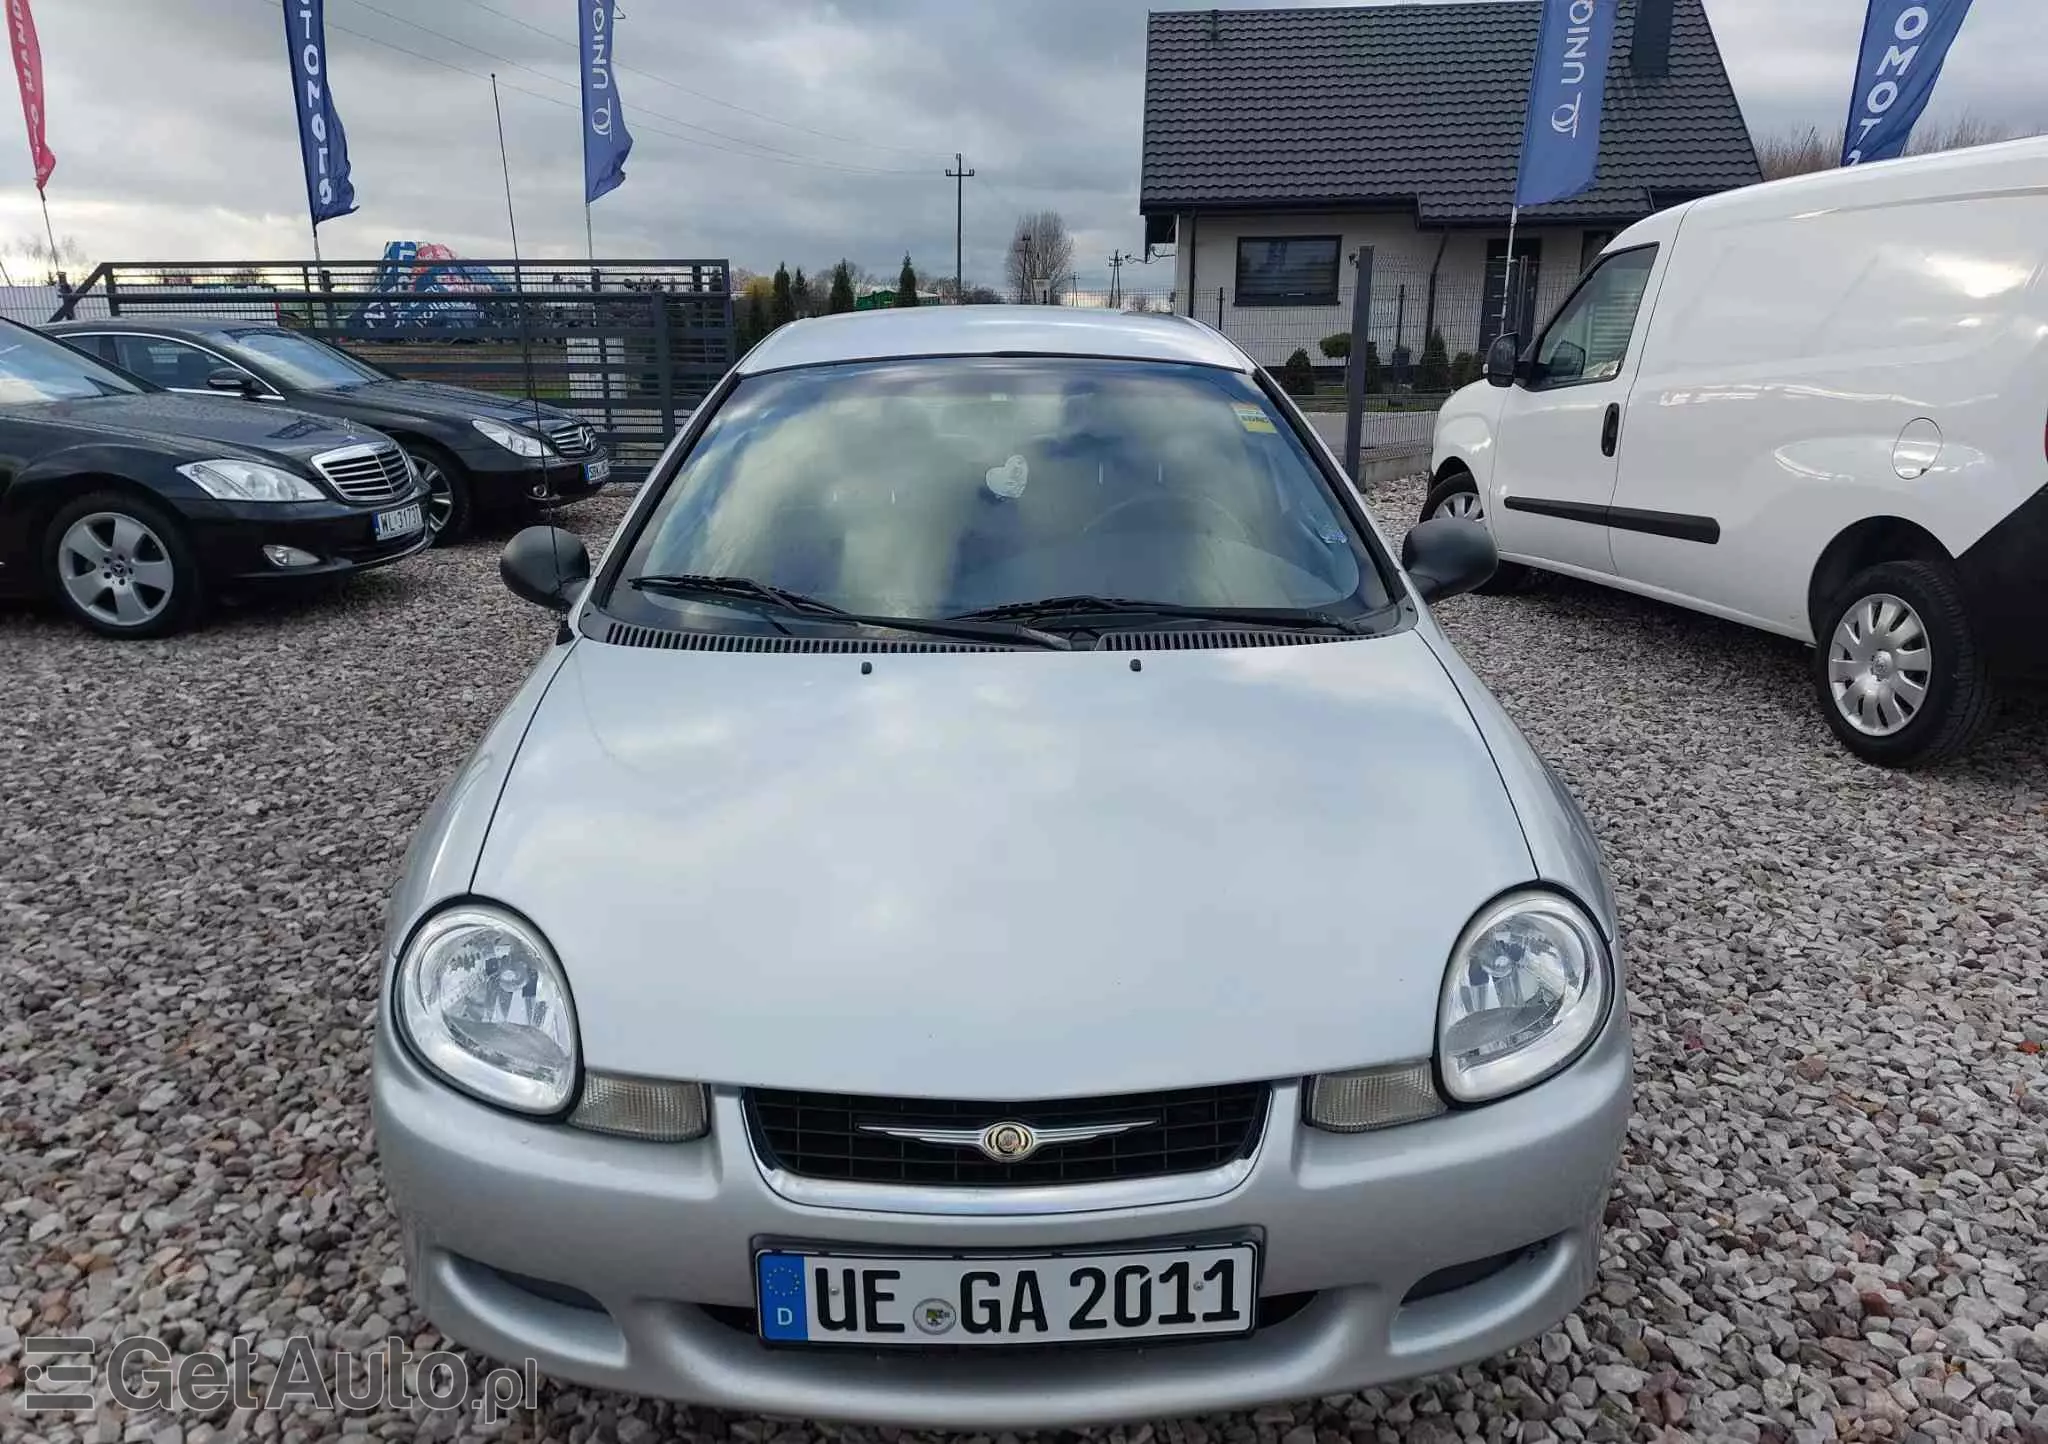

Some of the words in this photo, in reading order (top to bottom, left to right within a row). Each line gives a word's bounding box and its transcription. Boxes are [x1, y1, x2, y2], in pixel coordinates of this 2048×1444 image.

[591, 0, 609, 89] UNIQ
[299, 0, 333, 206] TOMOTO
[777, 1307, 793, 1326] D
[815, 1267, 905, 1333] UE
[959, 1270, 1049, 1334] GA
[1069, 1258, 1240, 1329] 2011
